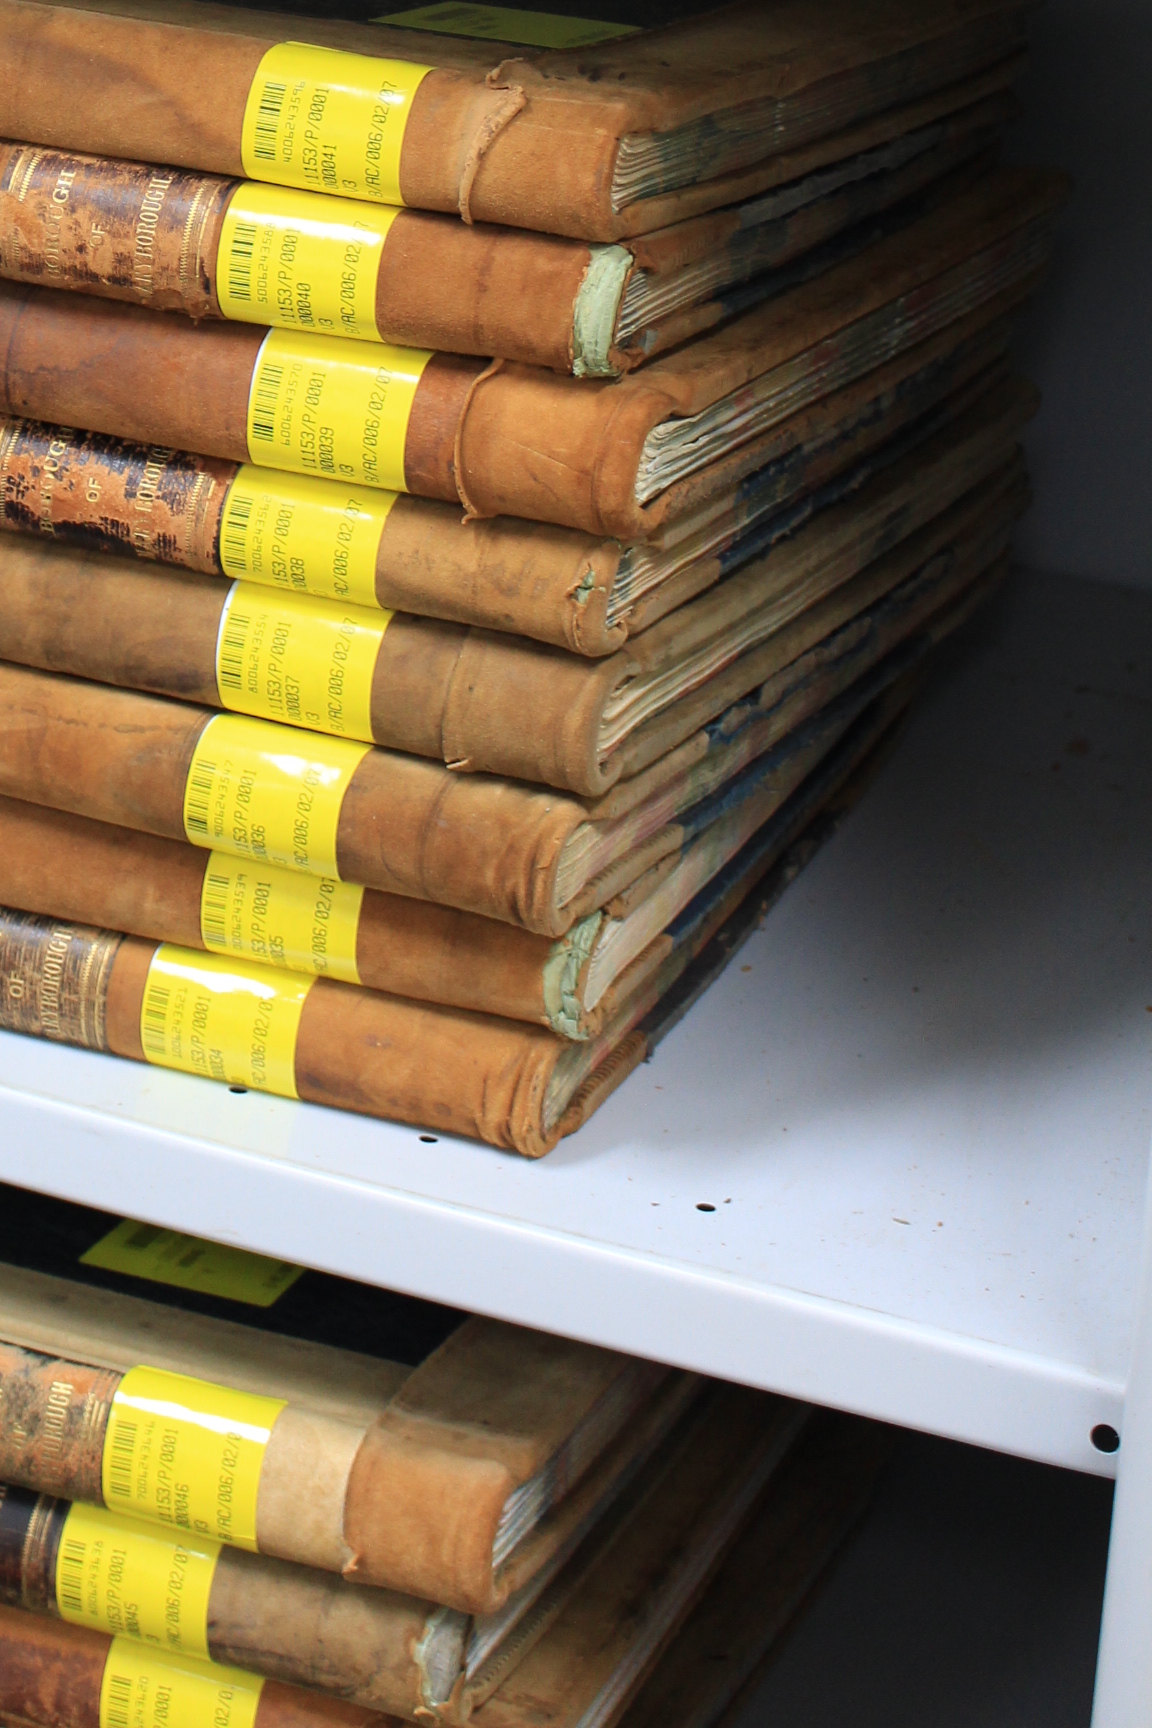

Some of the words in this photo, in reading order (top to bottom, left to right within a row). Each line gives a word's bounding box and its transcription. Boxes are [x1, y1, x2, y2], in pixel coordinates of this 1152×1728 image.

[302, 88, 330, 188] 11153/P/0001
[320, 145, 339, 191] 000041
[88, 223, 106, 249] OF
[296, 283, 315, 328] 000040
[299, 373, 326, 470] 11153/P/0001
[318, 427, 336, 475] 000039
[85, 478, 101, 504] OF
[333, 500, 362, 597] AC/006/02/07
[267, 622, 292, 718] 11153/P/0001
[8, 970, 25, 998] OF
[38, 927, 73, 1033] ARYBOROUG
[216, 1433, 243, 1543] B/AC/006/02/0
